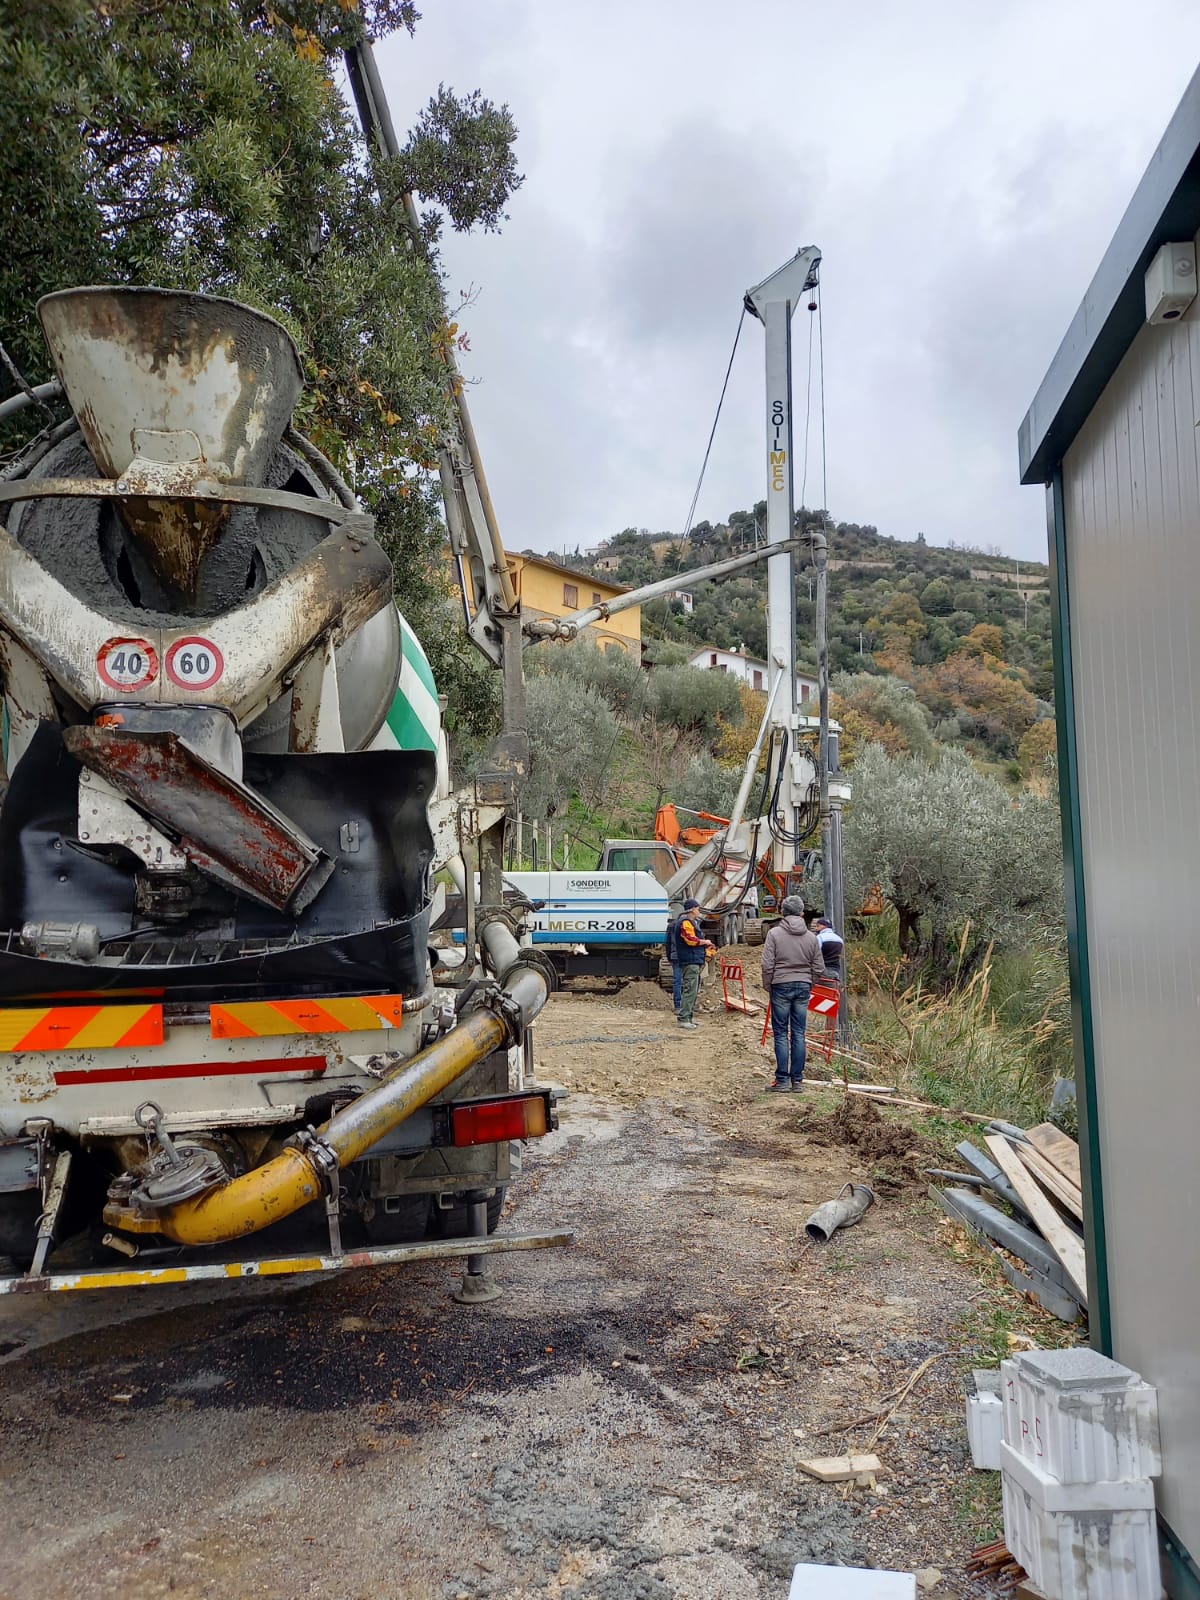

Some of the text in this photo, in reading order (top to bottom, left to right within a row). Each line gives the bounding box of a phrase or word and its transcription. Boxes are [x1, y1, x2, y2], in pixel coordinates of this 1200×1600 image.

[770, 400, 786, 492] SOILMEC
[111, 652, 142, 675] 40
[180, 652, 210, 675] 60
[570, 879, 612, 887] SONDEDIL
